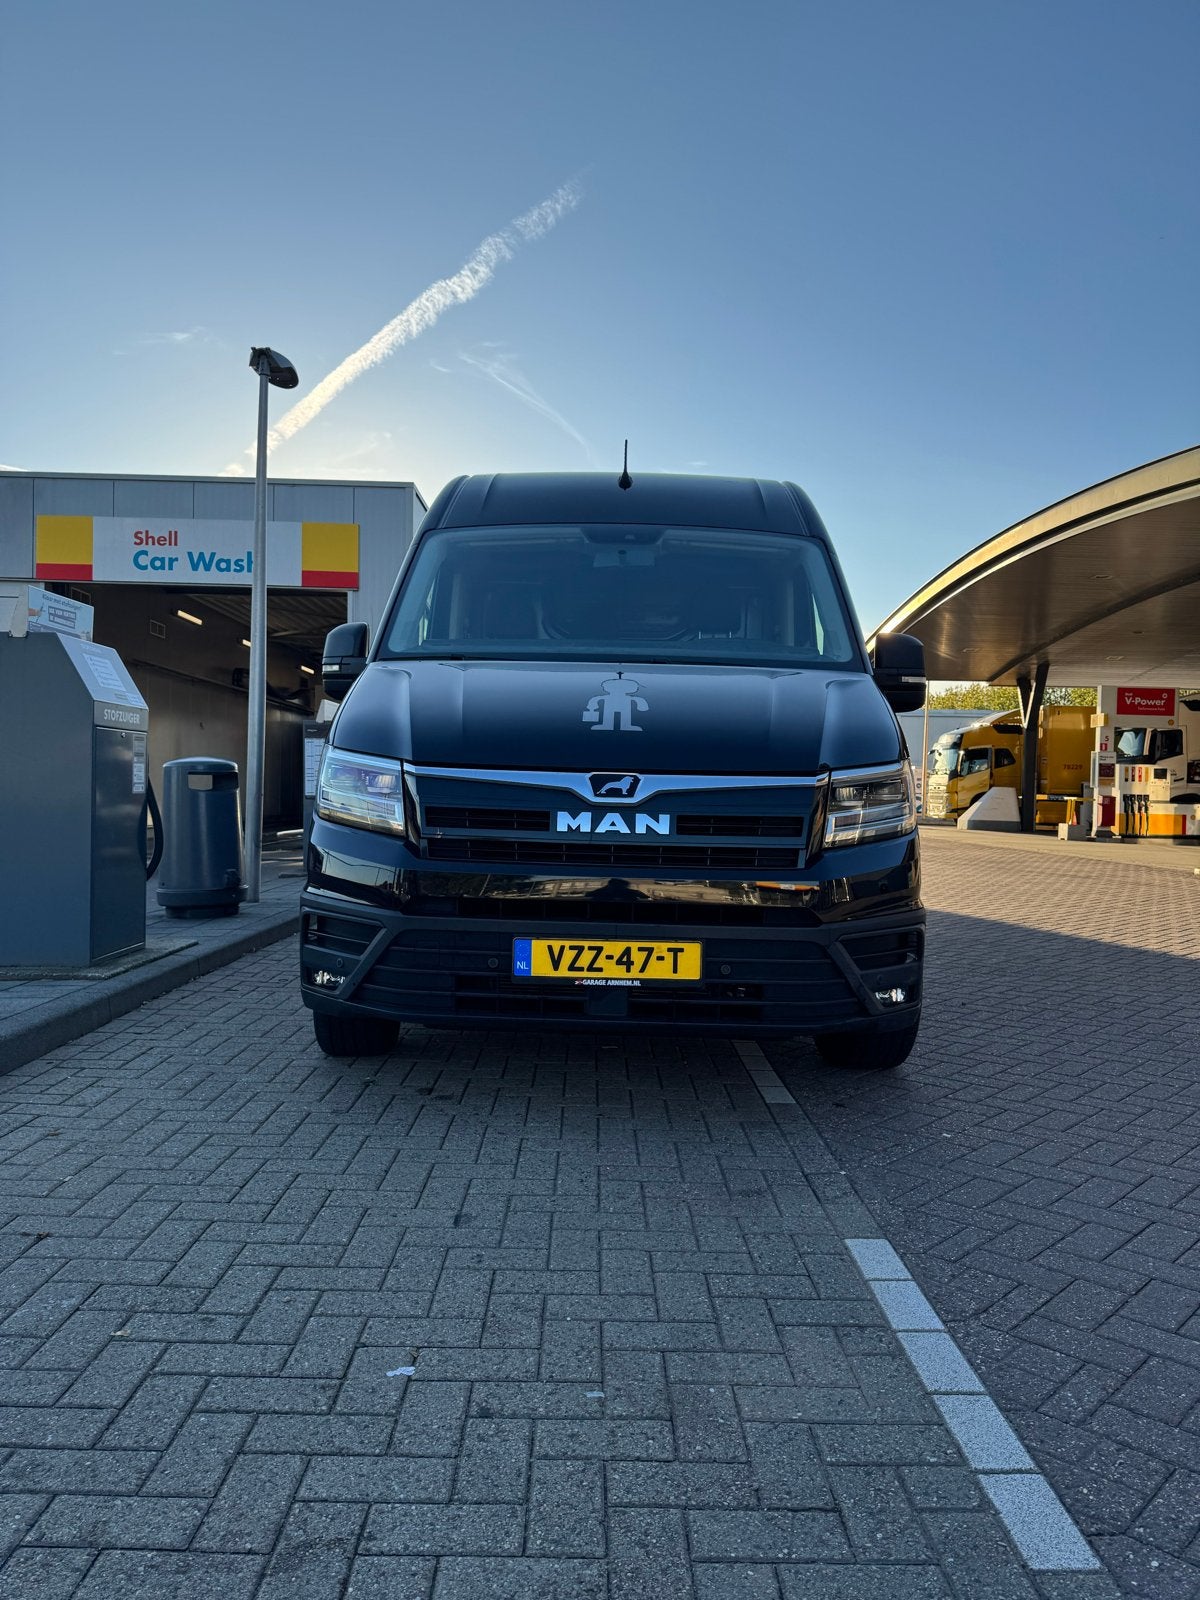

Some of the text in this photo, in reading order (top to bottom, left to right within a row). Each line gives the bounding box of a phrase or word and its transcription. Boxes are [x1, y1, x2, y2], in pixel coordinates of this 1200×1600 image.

[133, 530, 178, 546] Shell
[132, 549, 178, 571] Car
[1125, 697, 1166, 706] V-Power
[556, 811, 671, 835] MAN
[516, 944, 685, 974] NL VZZ-47-T
